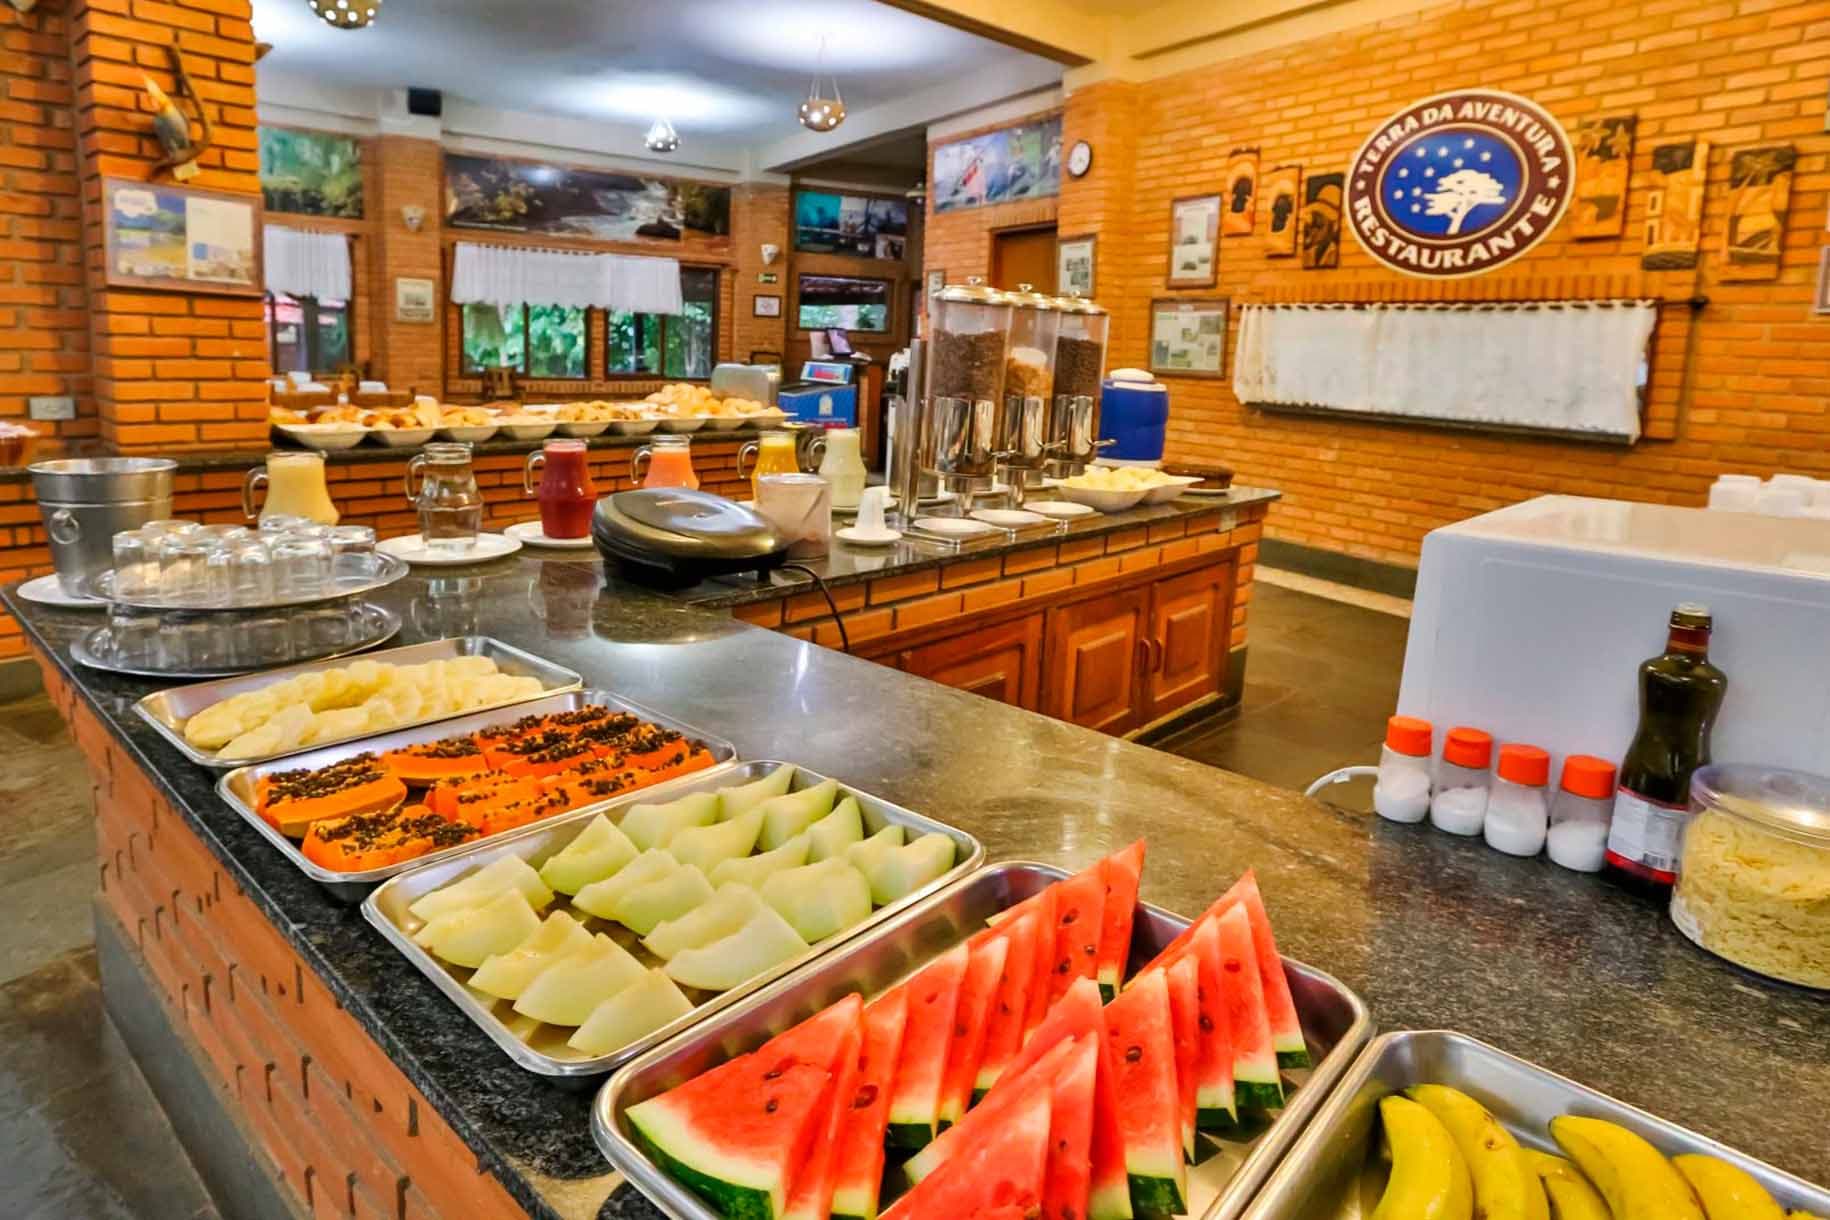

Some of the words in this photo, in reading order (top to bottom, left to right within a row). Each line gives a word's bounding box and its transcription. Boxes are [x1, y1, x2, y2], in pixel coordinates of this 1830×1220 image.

[1358, 114, 1420, 174] TERRA
[1421, 103, 1454, 126] DA
[1458, 101, 1562, 173] AVENTURA
[1353, 193, 1557, 269] RESTAURANTE
